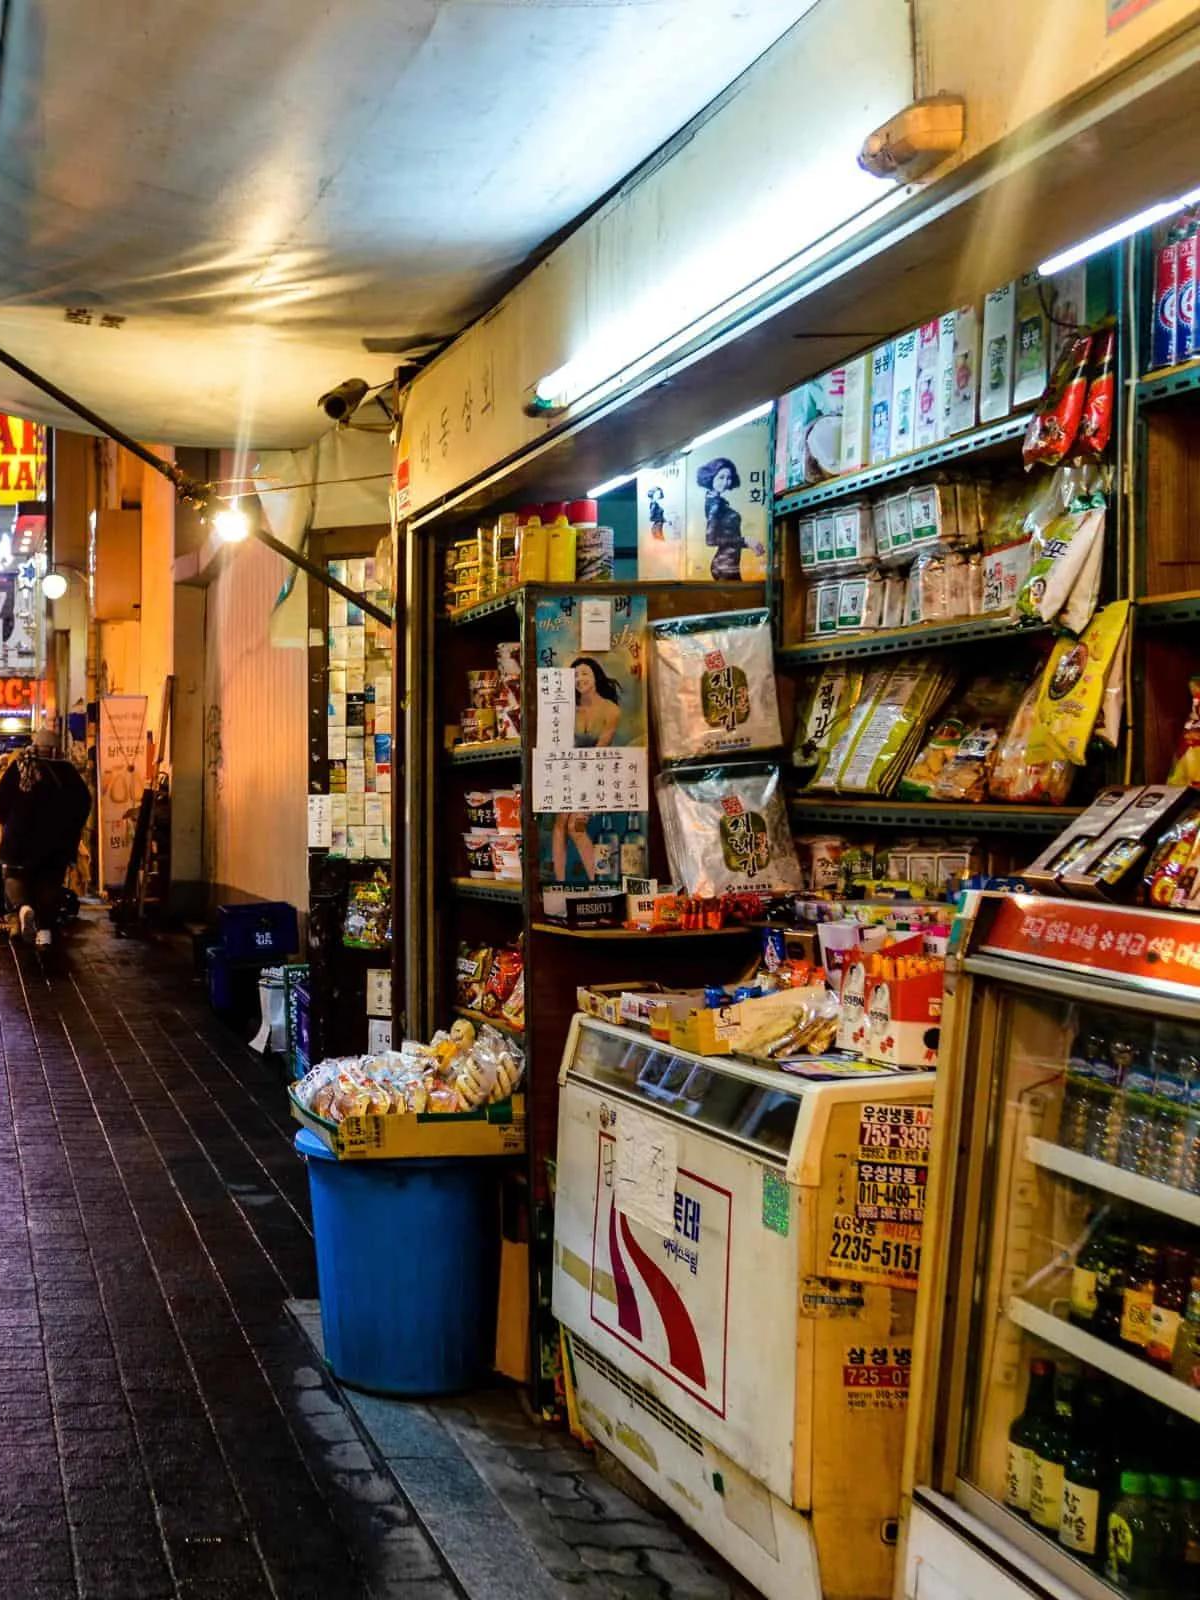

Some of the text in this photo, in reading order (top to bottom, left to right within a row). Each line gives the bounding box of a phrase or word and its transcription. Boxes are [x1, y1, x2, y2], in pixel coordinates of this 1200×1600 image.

[863, 1106, 915, 1125] 우성냉동
[861, 1123, 931, 1149] 753-339
[860, 1165, 917, 1184] 우성냉동
[830, 1232, 921, 1271] 2235-5151
